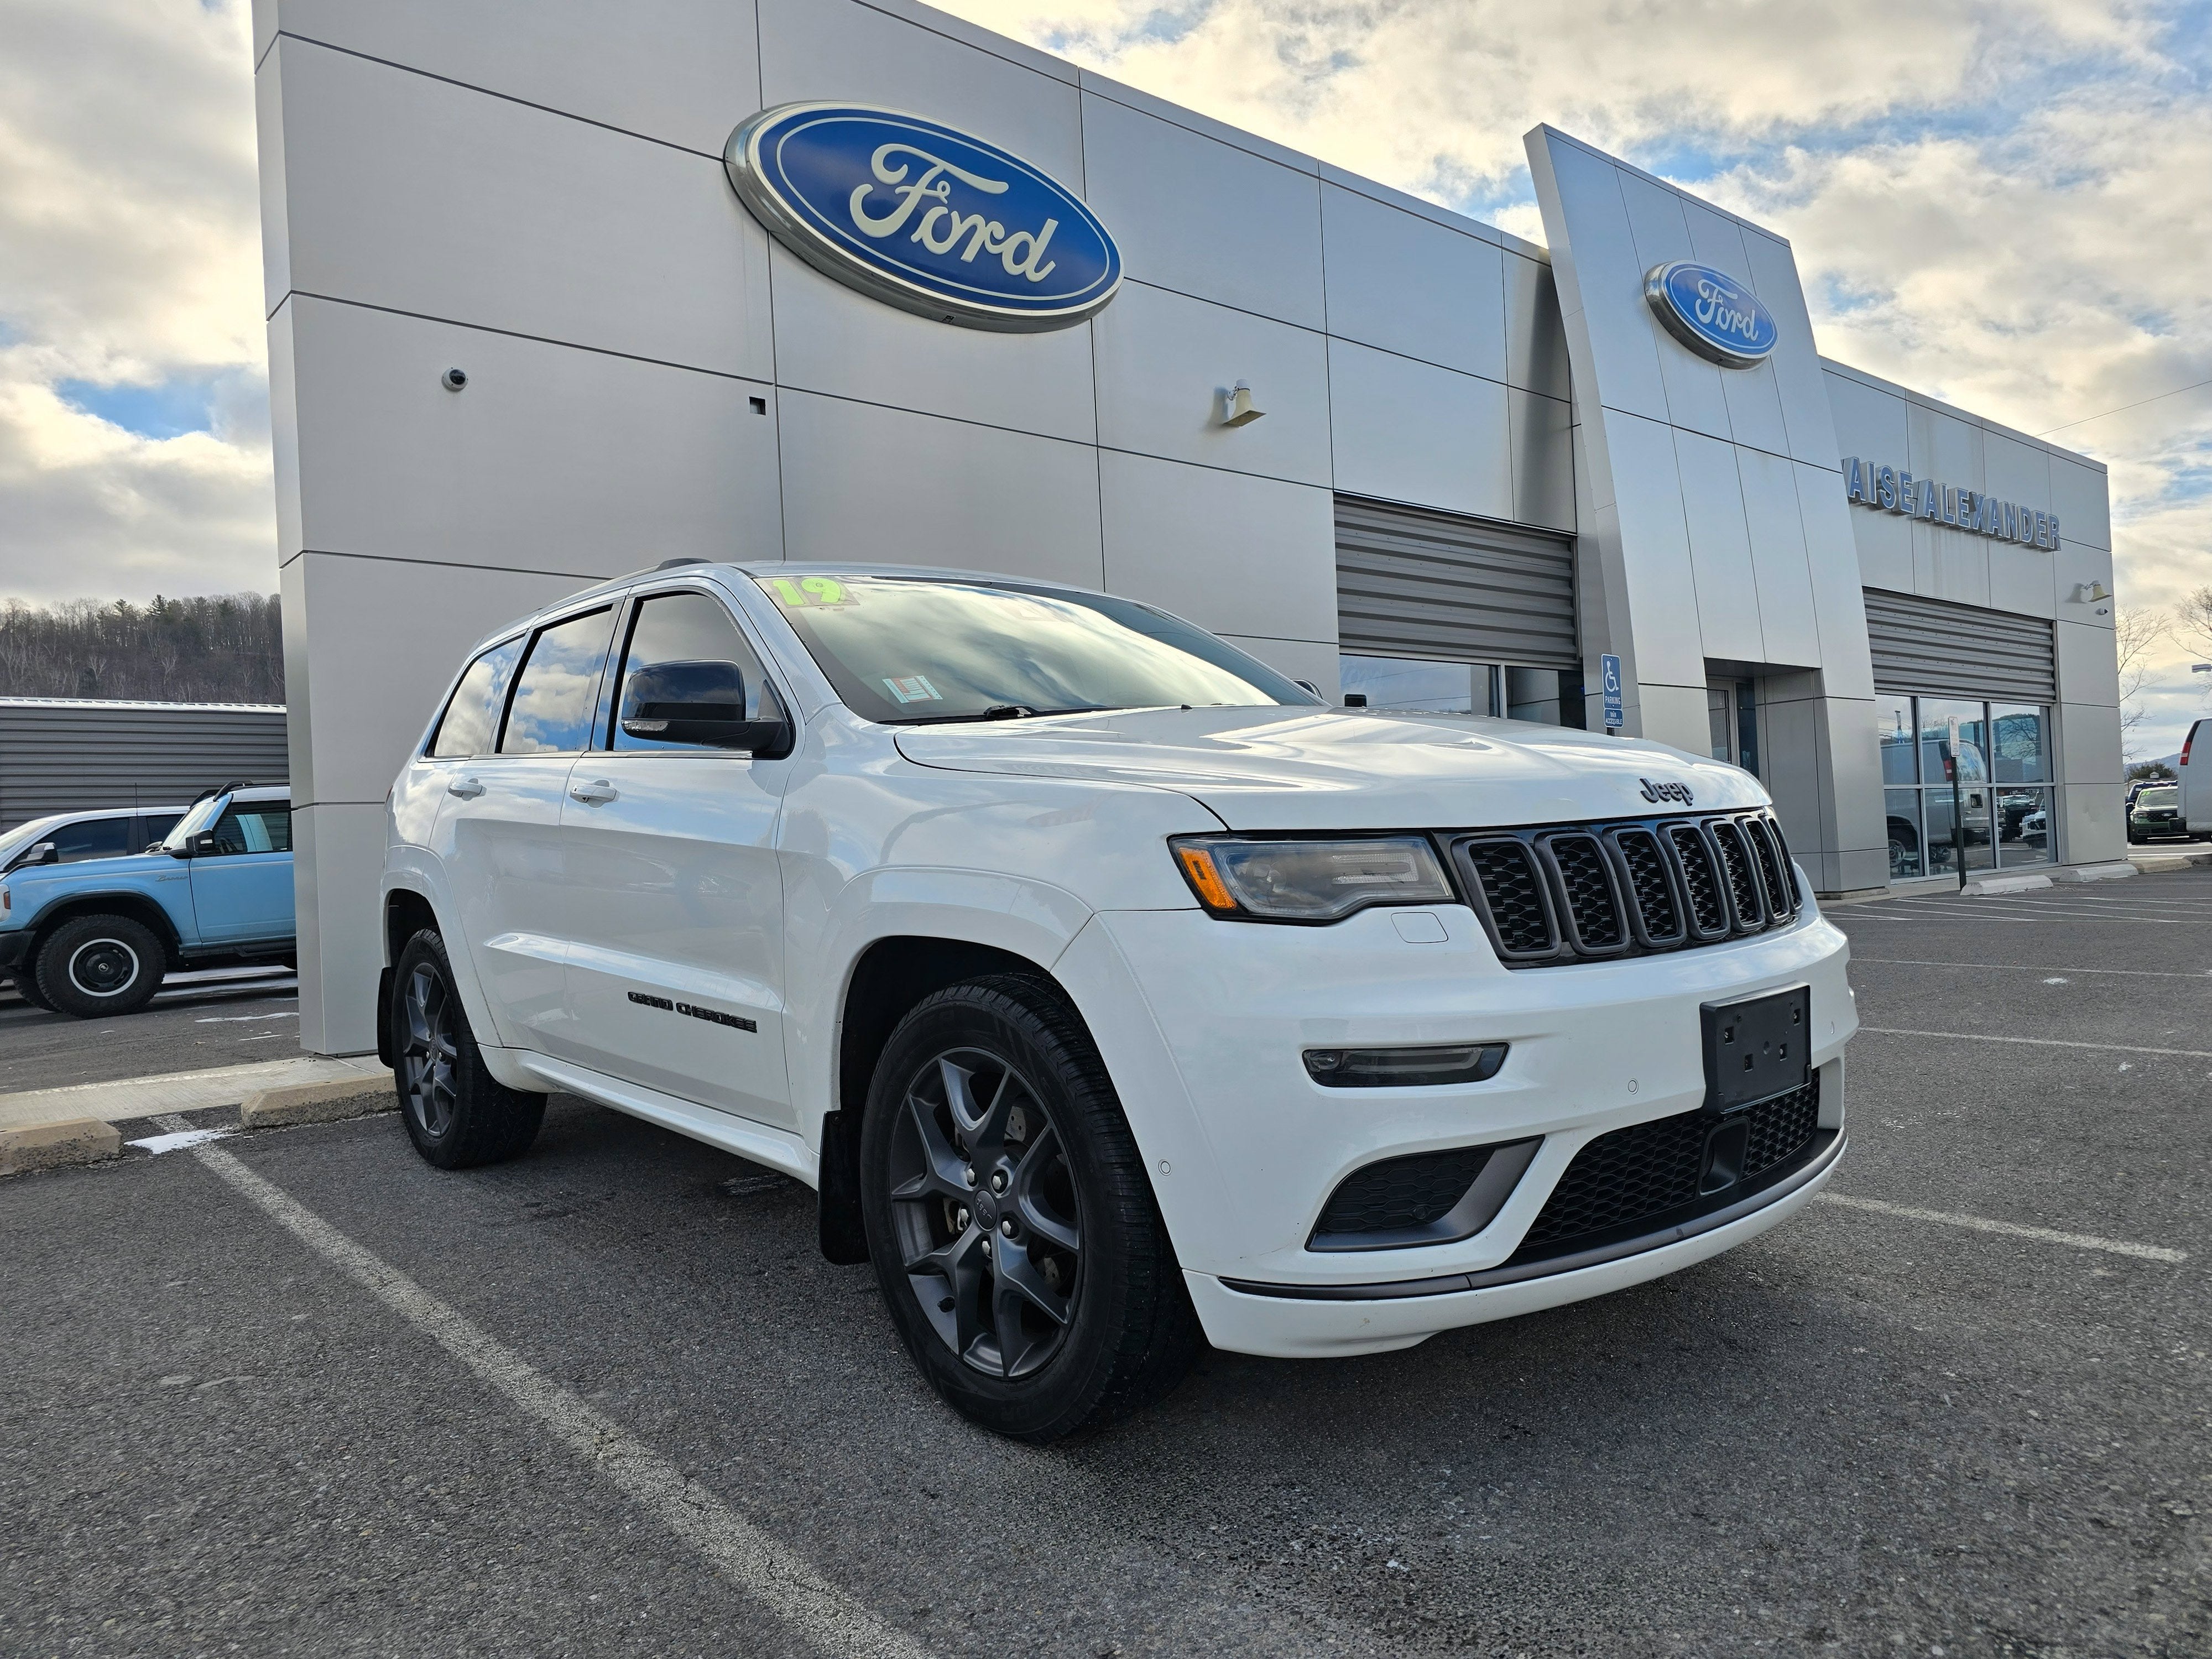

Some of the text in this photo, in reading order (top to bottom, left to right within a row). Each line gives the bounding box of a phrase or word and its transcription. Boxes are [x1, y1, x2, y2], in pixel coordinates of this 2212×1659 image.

[849, 143, 1059, 283] Ford
[1695, 279, 1758, 341] Ford
[1923, 479, 2062, 551] ALEXANDER
[773, 577, 841, 606] 19
[1605, 696, 1621, 705] PARKING
[1639, 778, 1694, 806] Jeep
[627, 991, 758, 1033] GRAND CHEROKEE
